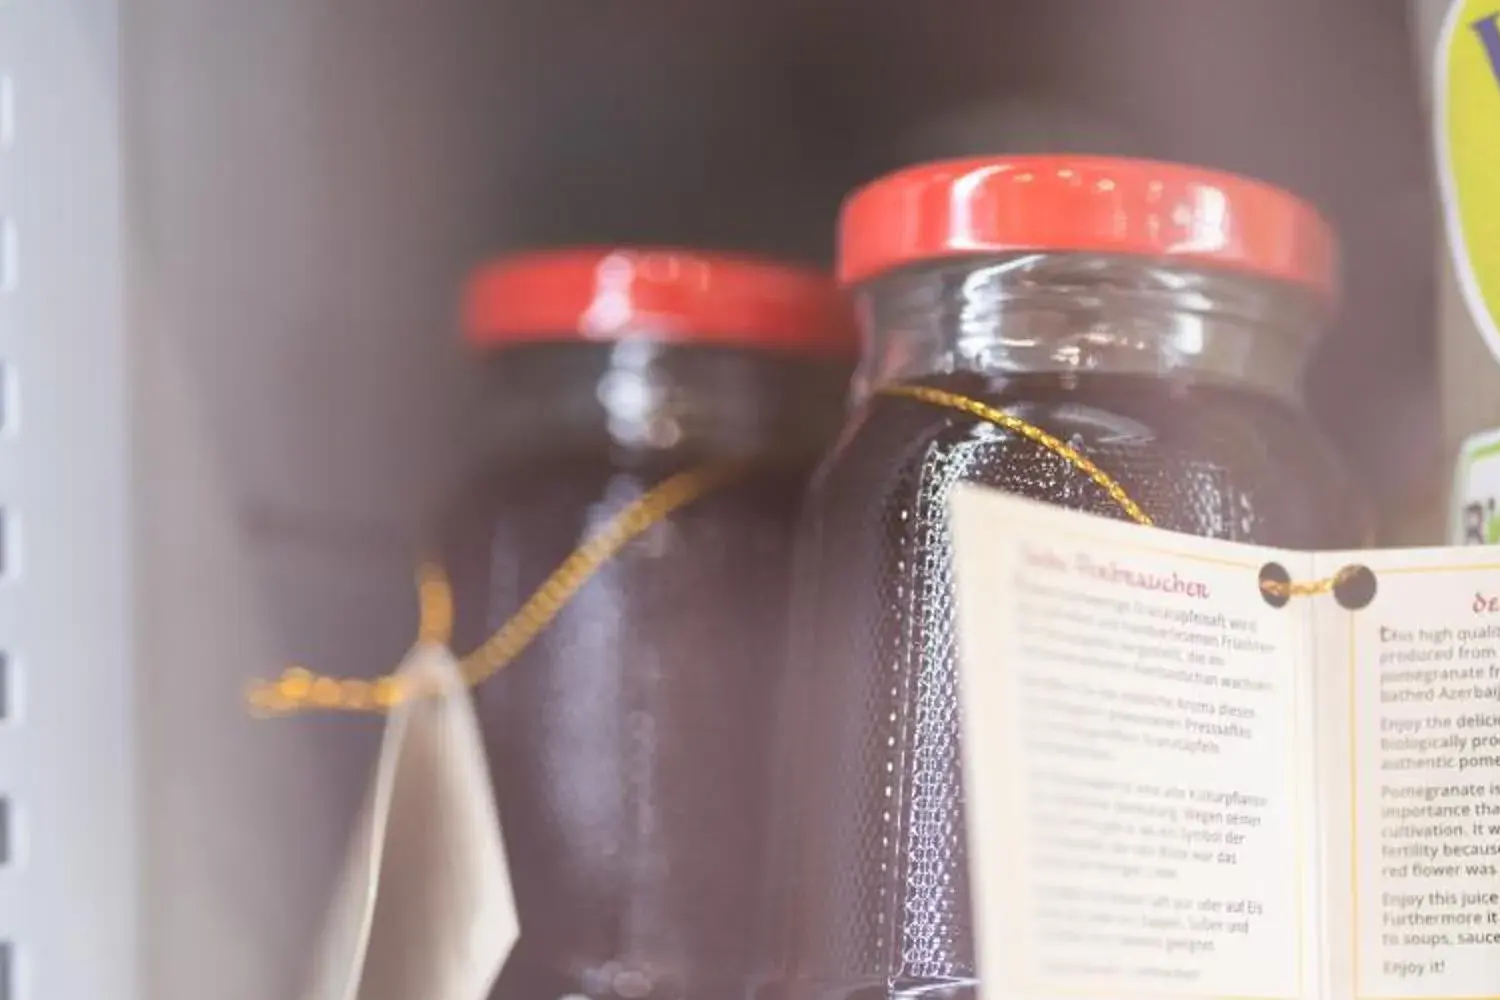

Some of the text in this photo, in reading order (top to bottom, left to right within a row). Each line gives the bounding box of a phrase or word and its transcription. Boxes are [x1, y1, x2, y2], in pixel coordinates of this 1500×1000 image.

[1458, 645, 1496, 660] from
[1426, 714, 1451, 728] the
[1465, 864, 1497, 877] was
[1428, 891, 1458, 906] this
[1460, 890, 1499, 908] juice
[1487, 910, 1498, 924] it
